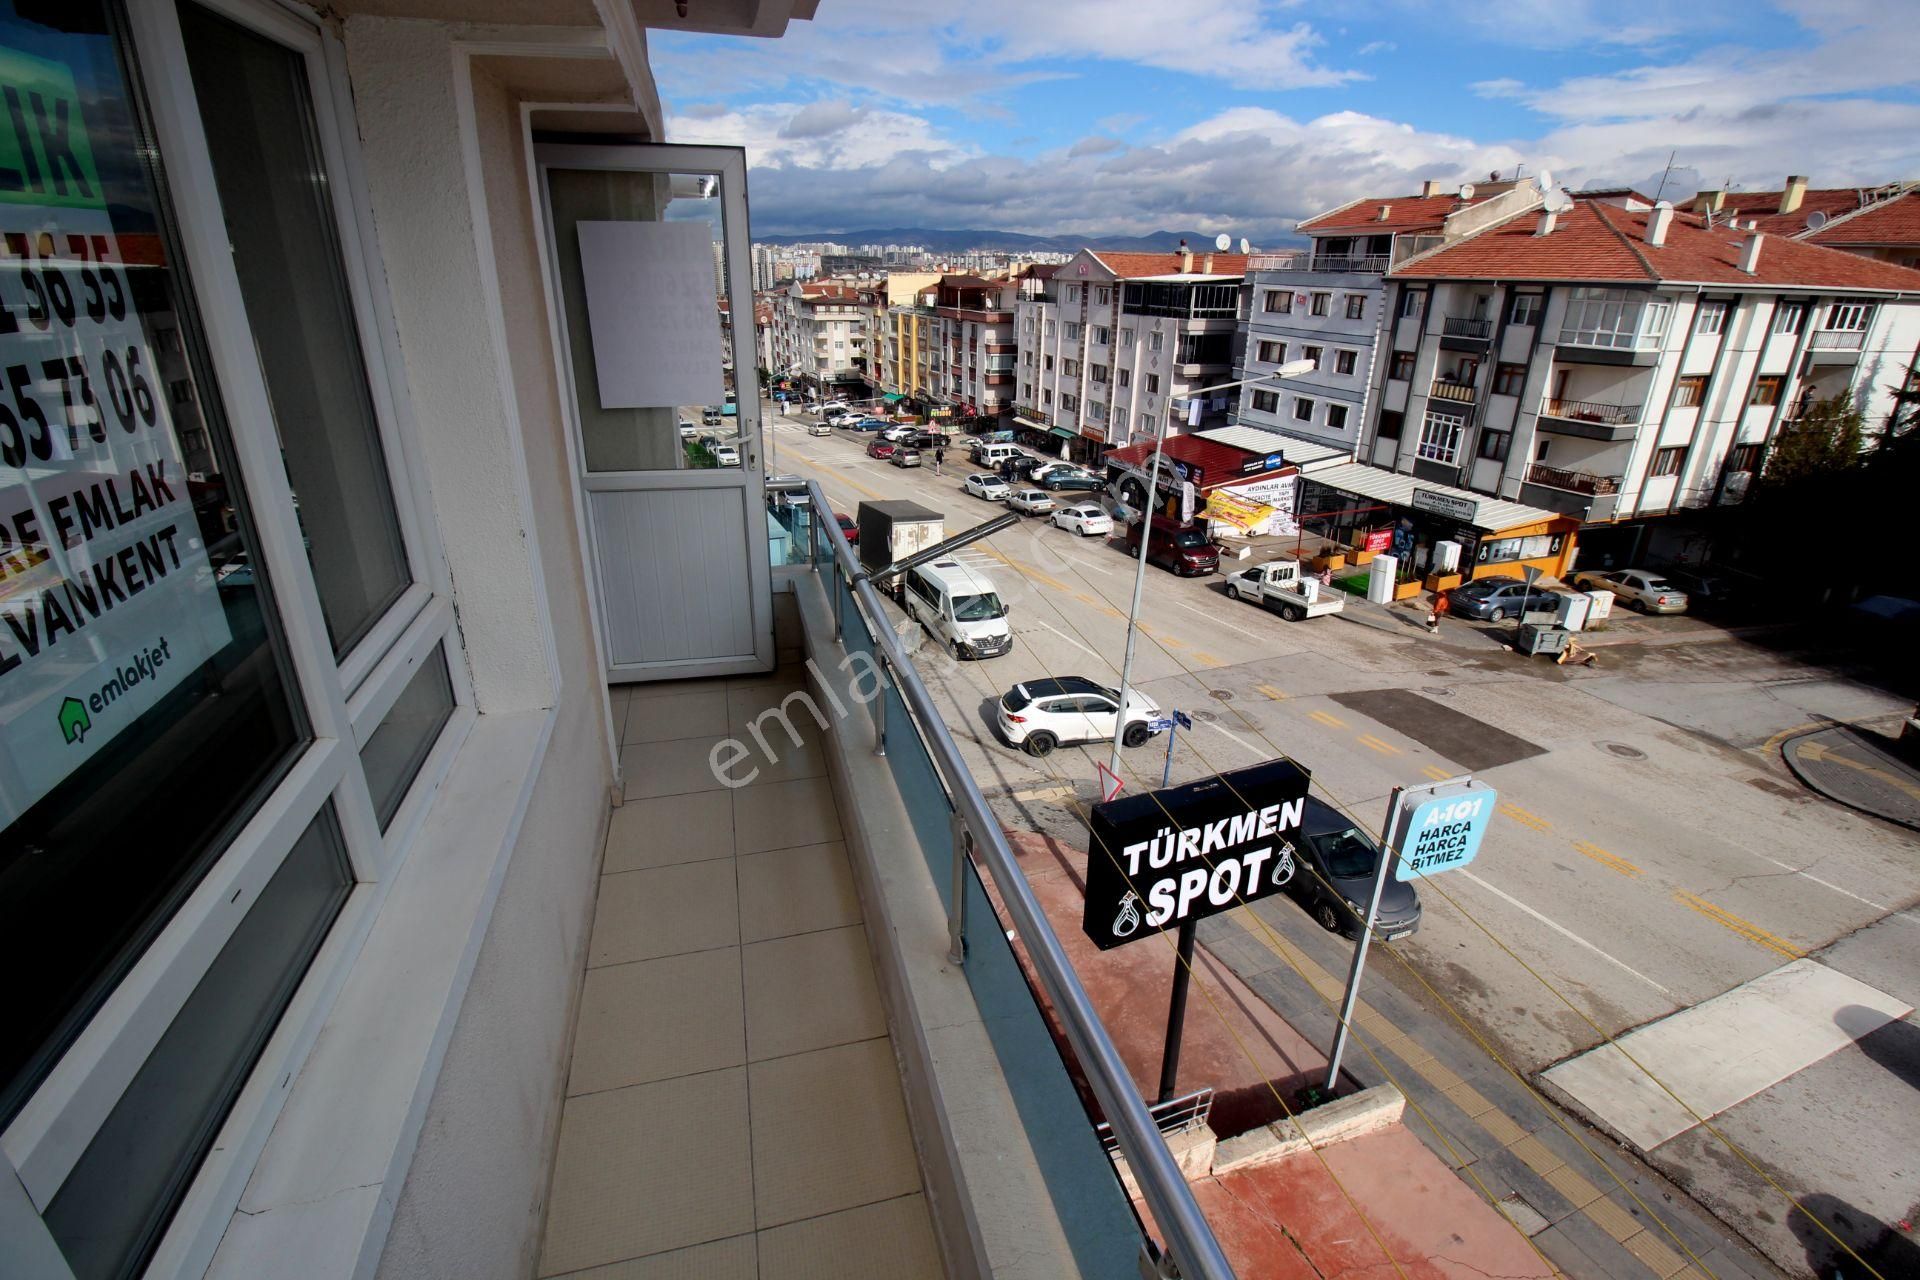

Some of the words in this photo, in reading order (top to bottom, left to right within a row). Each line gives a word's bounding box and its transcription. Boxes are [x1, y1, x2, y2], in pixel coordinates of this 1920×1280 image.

[4, 232, 75, 331] 36
[67, 233, 126, 325] 35
[42, 354, 107, 451] 73
[103, 345, 156, 434] 06
[47, 458, 177, 551] EMLAK
[1247, 483, 1279, 492] AYDINLAR
[1421, 492, 1450, 504] TÜRKMEN
[1450, 500, 1468, 508] SPOT
[89, 636, 170, 714] emlakjet
[1123, 797, 1305, 876] TÜRKMEN
[1414, 834, 1468, 857] HARCA
[1418, 820, 1472, 843] HARCA
[1145, 846, 1274, 928] SPOT
